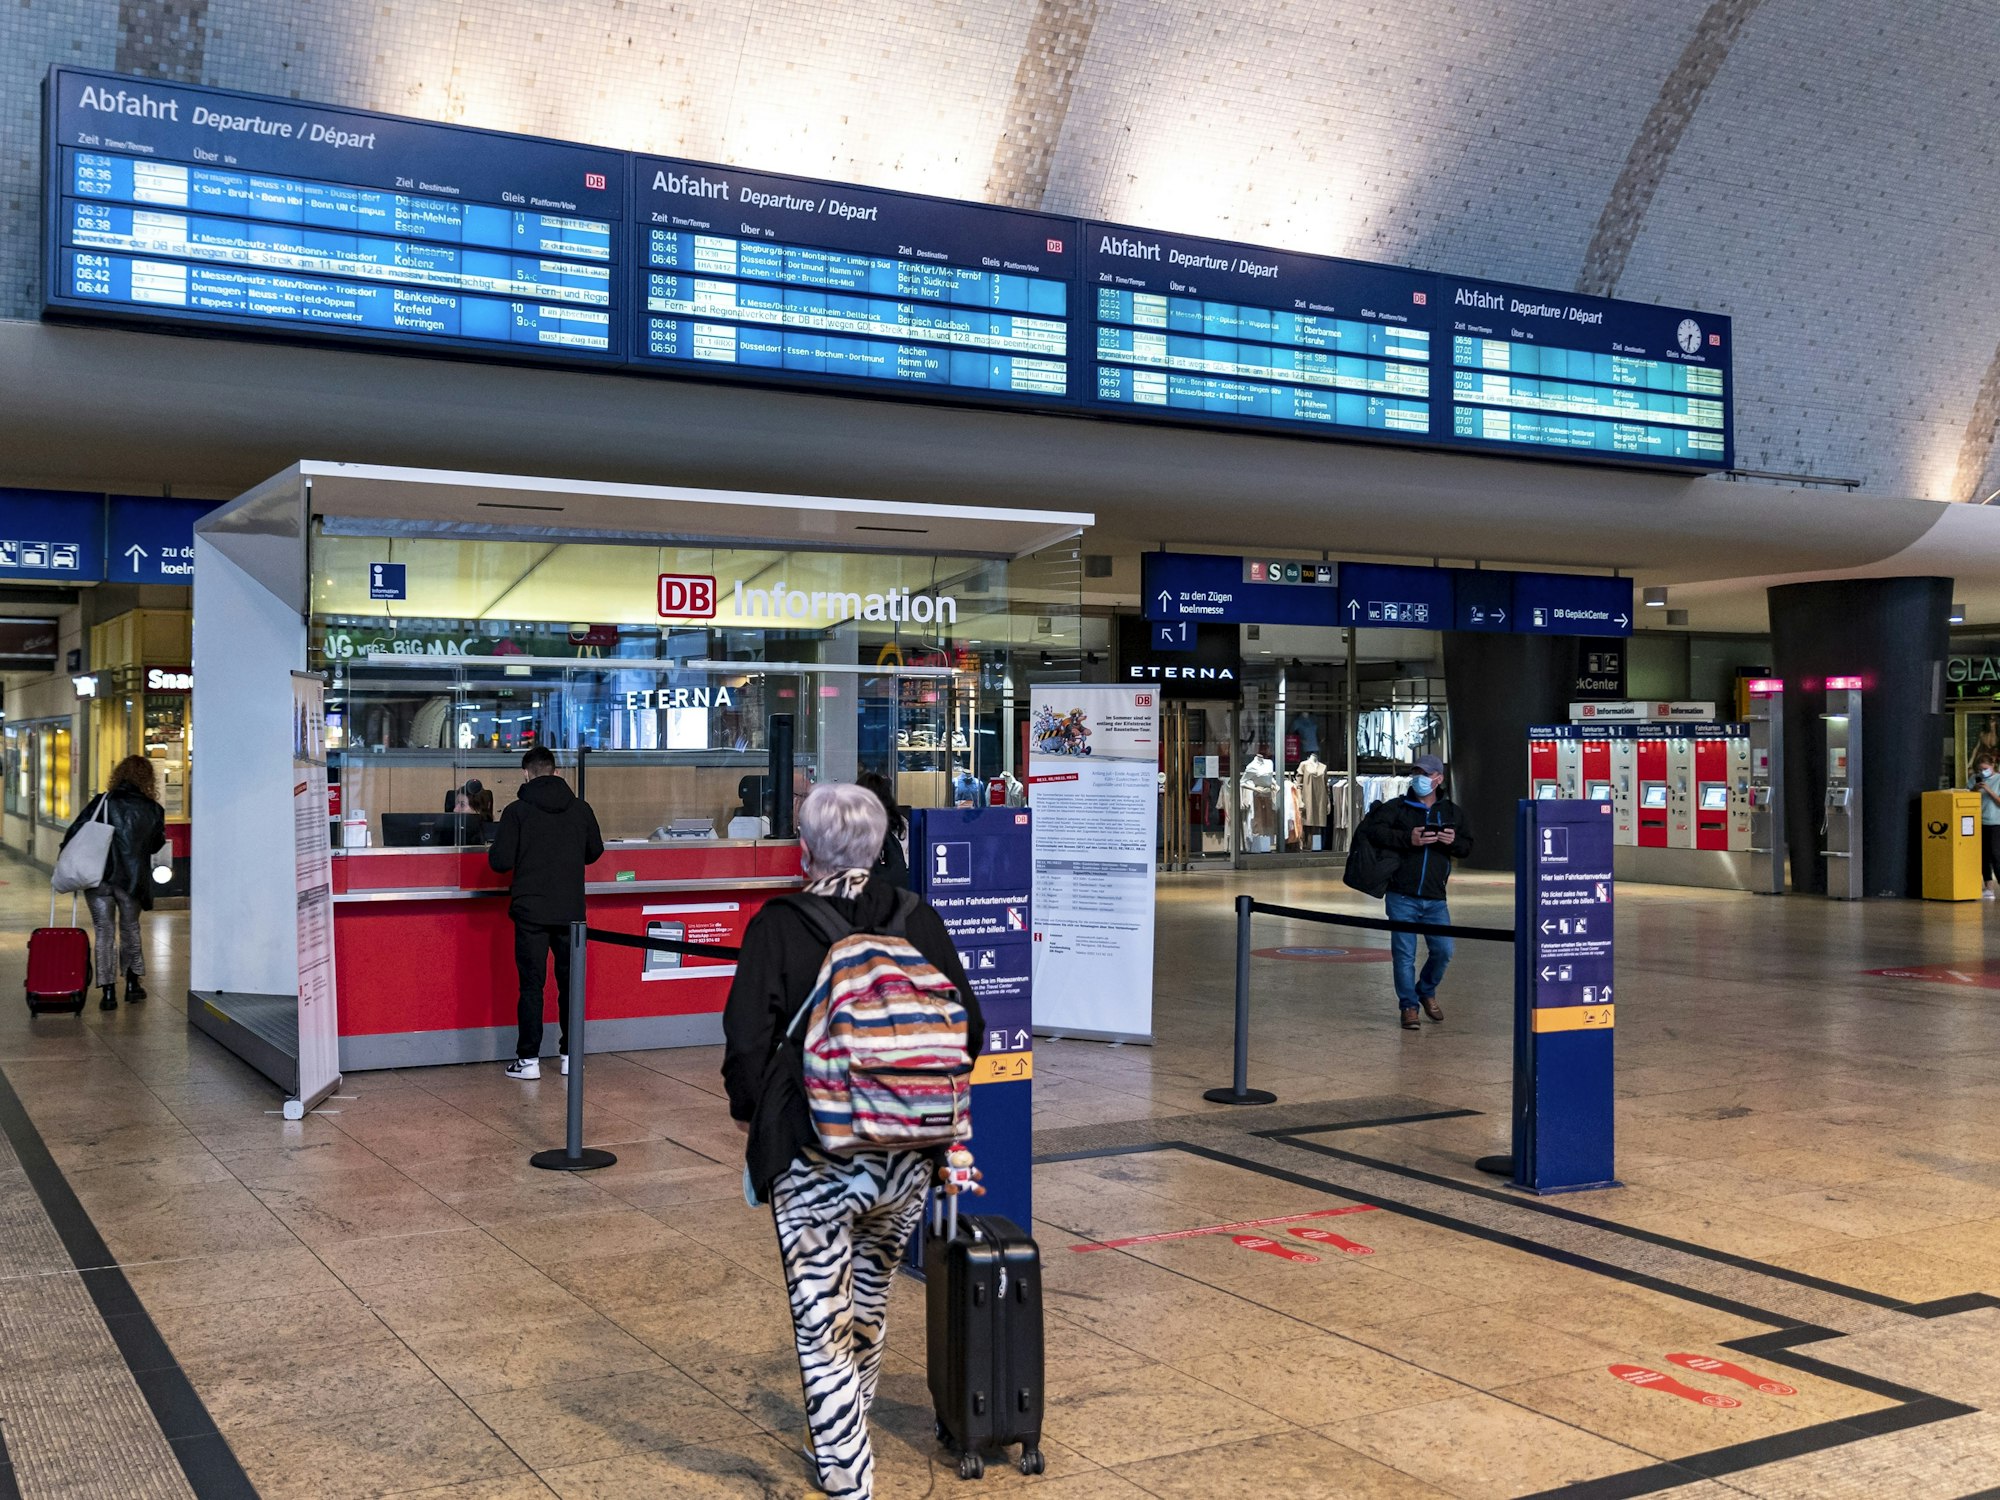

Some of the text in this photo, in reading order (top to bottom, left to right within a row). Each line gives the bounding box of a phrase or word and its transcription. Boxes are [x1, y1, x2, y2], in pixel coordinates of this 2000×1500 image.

[79, 85, 376, 150] Abfahrt Departure Départ
[77, 132, 154, 153] Zeit Time/Temps
[193, 146, 219, 162] Über
[395, 176, 460, 194] Ziel Destination
[586, 174, 605, 188] DB
[501, 191, 577, 211] Gleis Platform/Voie
[652, 171, 878, 221] Abfahrt Departure Départ
[395, 208, 462, 226] Bonn-Mehlem
[652, 212, 710, 229] Zeit Time/Temps
[395, 220, 425, 234] Essen
[741, 222, 775, 237] Über Via
[652, 230, 678, 242] 06:44
[652, 242, 678, 254] 06:45
[898, 245, 948, 260] Ziel Destination
[1048, 241, 1062, 253] DB
[77, 254, 110, 267] 06:41
[394, 255, 434, 270] Koblenz
[652, 254, 678, 266] 06:45
[1099, 236, 1279, 279] Abfahrt Departure Départ
[982, 256, 1040, 272] Gleis Platform/Voie
[76, 268, 110, 281] 06:42
[652, 274, 678, 286] 06:46
[898, 273, 922, 284] Berlin
[956, 269, 982, 281] Fernbf
[1099, 272, 1112, 282] Zeit
[76, 281, 110, 295] 06:44
[652, 286, 678, 298] 06:47
[898, 284, 940, 297] Paris Nord
[1170, 280, 1185, 292] Über
[394, 289, 456, 308] Blankenberg
[1294, 299, 1306, 309] Ziel
[1414, 294, 1426, 304] DB
[394, 302, 432, 316] Krefeld
[898, 302, 915, 314] Kall
[1454, 288, 1603, 324] Abfahrt Departure Départ
[1361, 308, 1376, 318] Gleis
[394, 315, 445, 332] Worringen
[651, 318, 677, 330] 06:48
[898, 315, 970, 331] Bergisch Gladbach
[651, 330, 677, 342] 06:49
[651, 342, 677, 354] 06:50
[898, 345, 928, 357] Aachen
[898, 357, 939, 370] Hamm (W)
[898, 369, 927, 380] Horrem
[162, 547, 177, 557] zu
[1269, 563, 1281, 581] S
[1287, 569, 1298, 577] Bus
[664, 580, 957, 624] DB Information
[1180, 591, 1232, 603] zu den Zügen
[1179, 603, 1224, 615] koelnmesse
[1369, 610, 1380, 618] WC
[1554, 608, 1609, 620] DB GepäckCenter
[1178, 621, 1187, 641] 1
[1130, 666, 1234, 680] ETERNA
[1947, 657, 2000, 682] GLA
[626, 686, 732, 710] ETERNA
[1136, 696, 1151, 705] DB
[1597, 708, 1634, 716] Information
[1670, 707, 1704, 715] Information
[1016, 816, 1027, 824] DB
[1565, 872, 1611, 880] Fahrkartenverkauf
[932, 895, 1028, 907] Hier kein Fahrkartenverkauf
[963, 918, 980, 926] sales
[982, 917, 997, 925] here
[957, 927, 976, 935] vente
[976, 926, 986, 934] de
[986, 926, 1006, 934] billets
